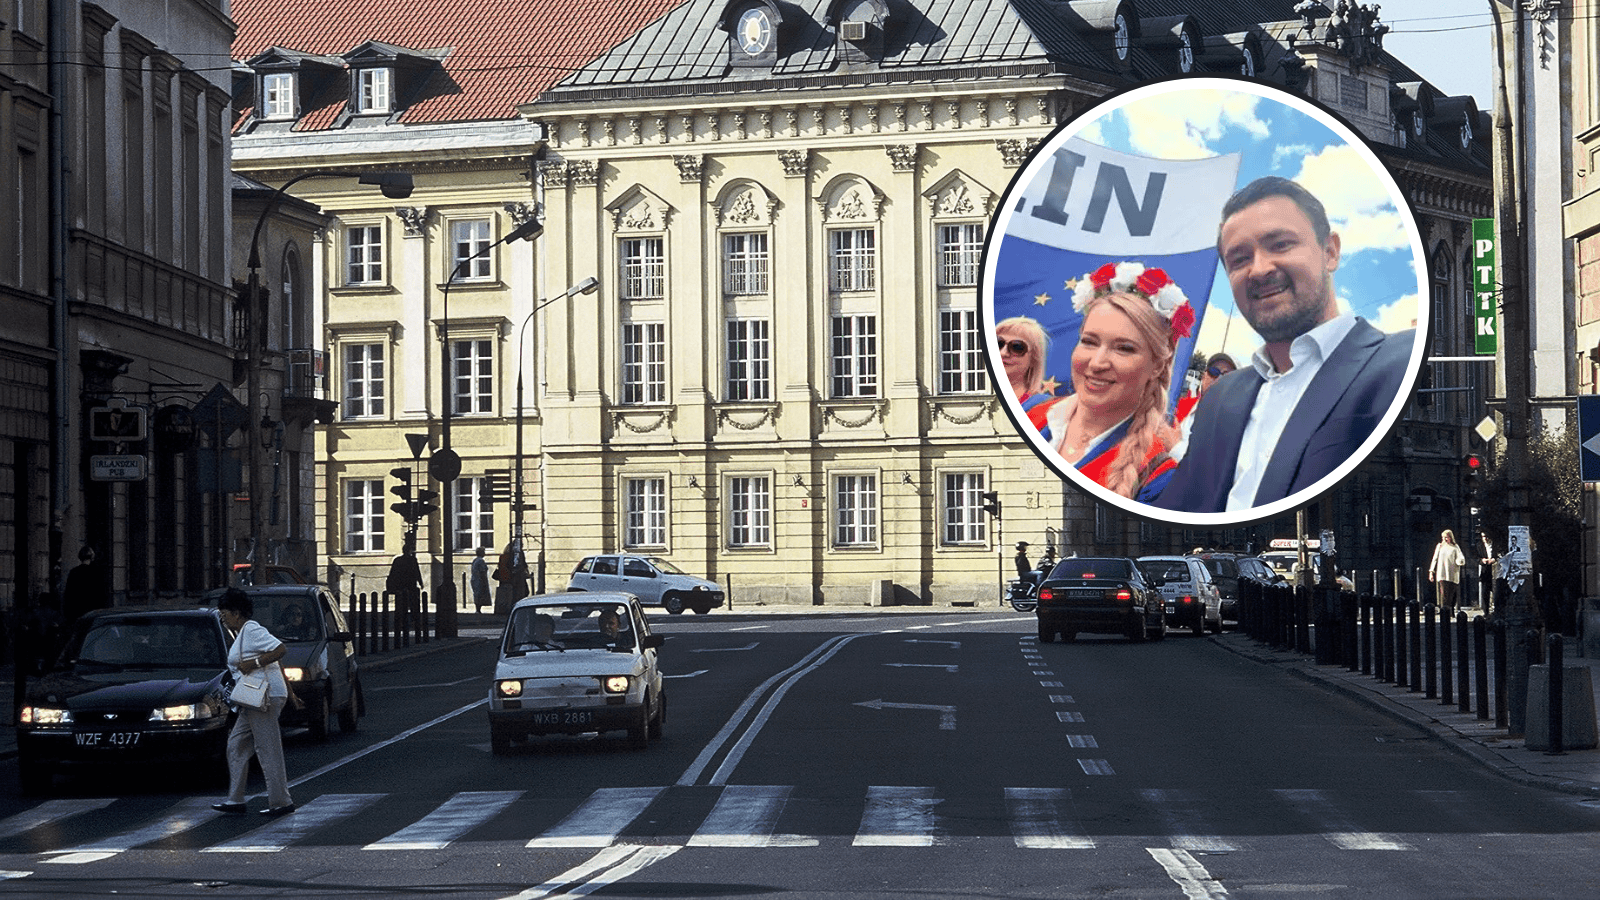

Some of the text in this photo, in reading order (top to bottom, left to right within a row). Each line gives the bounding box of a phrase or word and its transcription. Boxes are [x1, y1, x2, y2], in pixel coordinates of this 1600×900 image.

[1014, 147, 1168, 237] IN
[1475, 239, 1495, 336] PTTK
[96, 460, 138, 468] IRLANDZKI
[109, 468, 125, 476] PUB
[534, 711, 592, 725] WXB 2881
[75, 732, 141, 746] WZF 4377
